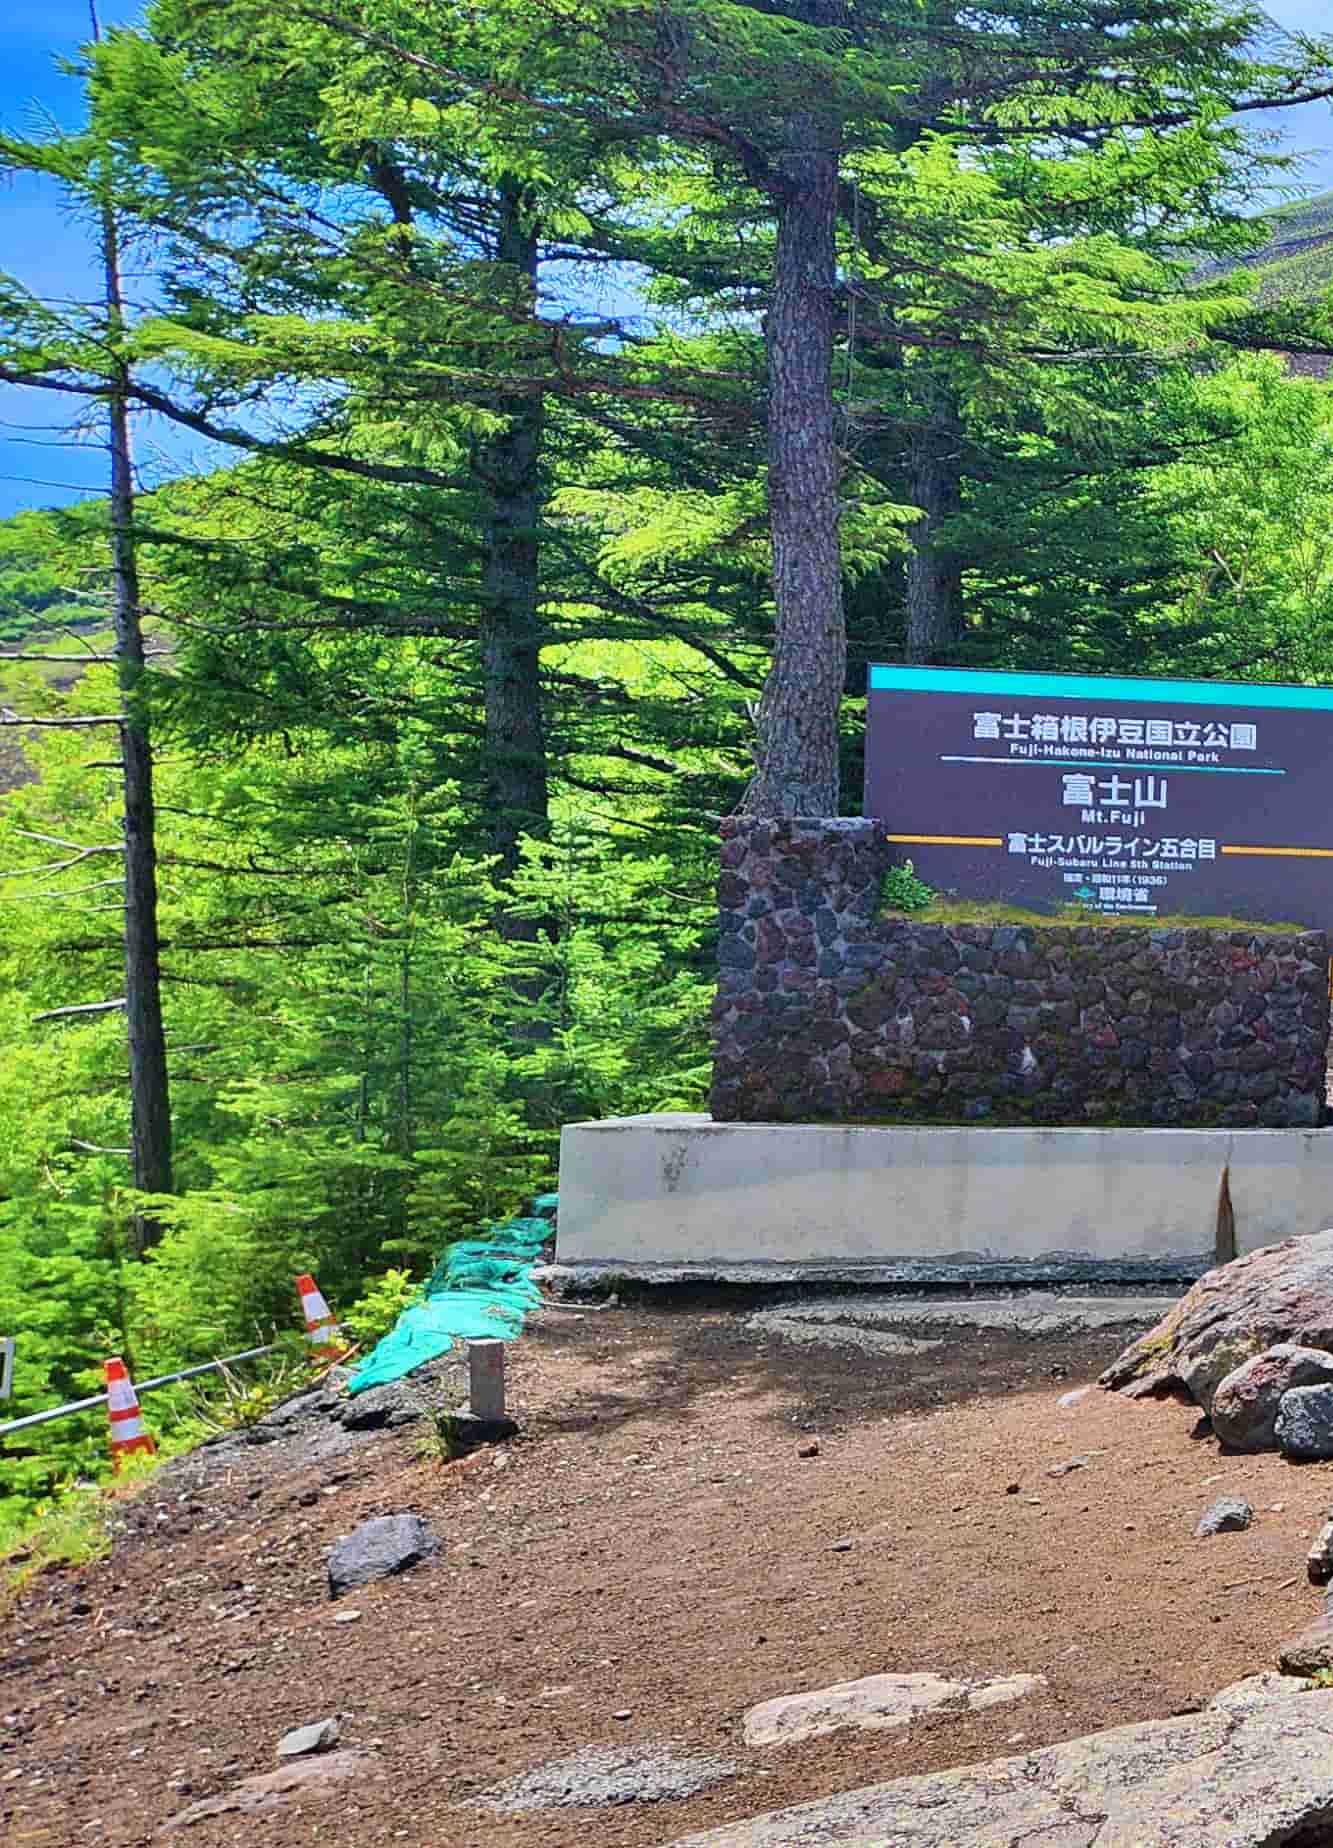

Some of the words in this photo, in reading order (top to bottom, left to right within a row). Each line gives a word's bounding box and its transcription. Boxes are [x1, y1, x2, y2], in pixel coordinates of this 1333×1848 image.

[973, 712, 1257, 750] 富士箱根伊豆国立公園
[1010, 743, 1121, 759] Fuji-Hakone-Izu
[1126, 748, 1182, 762] National
[1187, 750, 1220, 763] Park
[1062, 773, 1168, 808] 富士山
[1081, 809, 1145, 827] Mt.Fuji
[1007, 832, 1216, 860] 富士スバルライン五合目
[1031, 856, 1098, 869] Fuji-Subaru
[1102, 857, 1126, 869] Line
[1151, 859, 1193, 871] Station
[1099, 887, 1149, 902] 環境省
